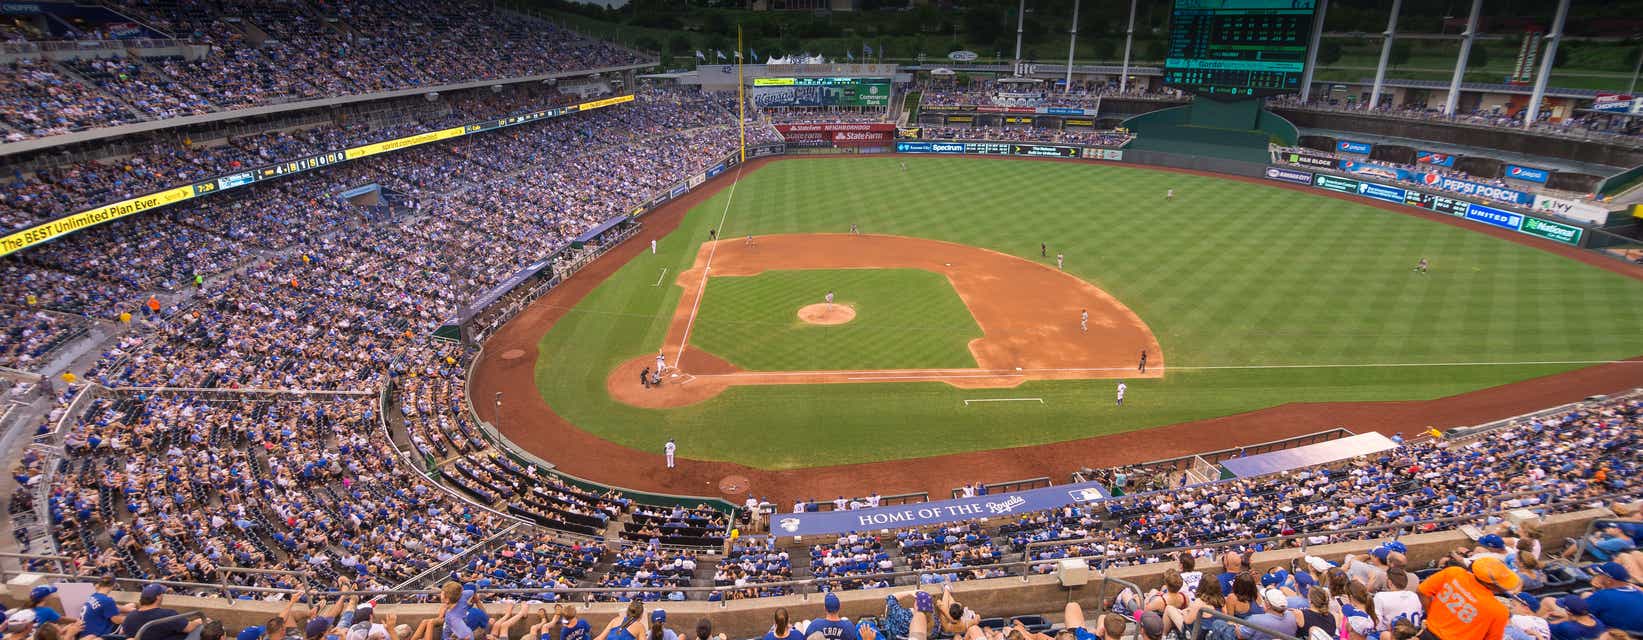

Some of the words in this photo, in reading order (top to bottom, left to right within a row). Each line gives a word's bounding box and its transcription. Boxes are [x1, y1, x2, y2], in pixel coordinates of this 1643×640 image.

[755, 91, 794, 107] Kansas
[932, 144, 962, 152] Spectrum
[1443, 179, 1476, 194] PEPSI
[1476, 185, 1519, 202] PORCH
[1, 238, 23, 252] The
[24, 225, 52, 243] BEST
[54, 209, 109, 233] Unlimited
[110, 204, 134, 217] Plan
[134, 198, 161, 210] Ever.
[1470, 209, 1508, 222] UNITED
[1537, 222, 1576, 237] National
[858, 510, 916, 526] HOME
[918, 508, 943, 519] OF
[944, 503, 983, 516] THE
[985, 496, 1026, 514] Royals
[1437, 582, 1478, 624] 328
